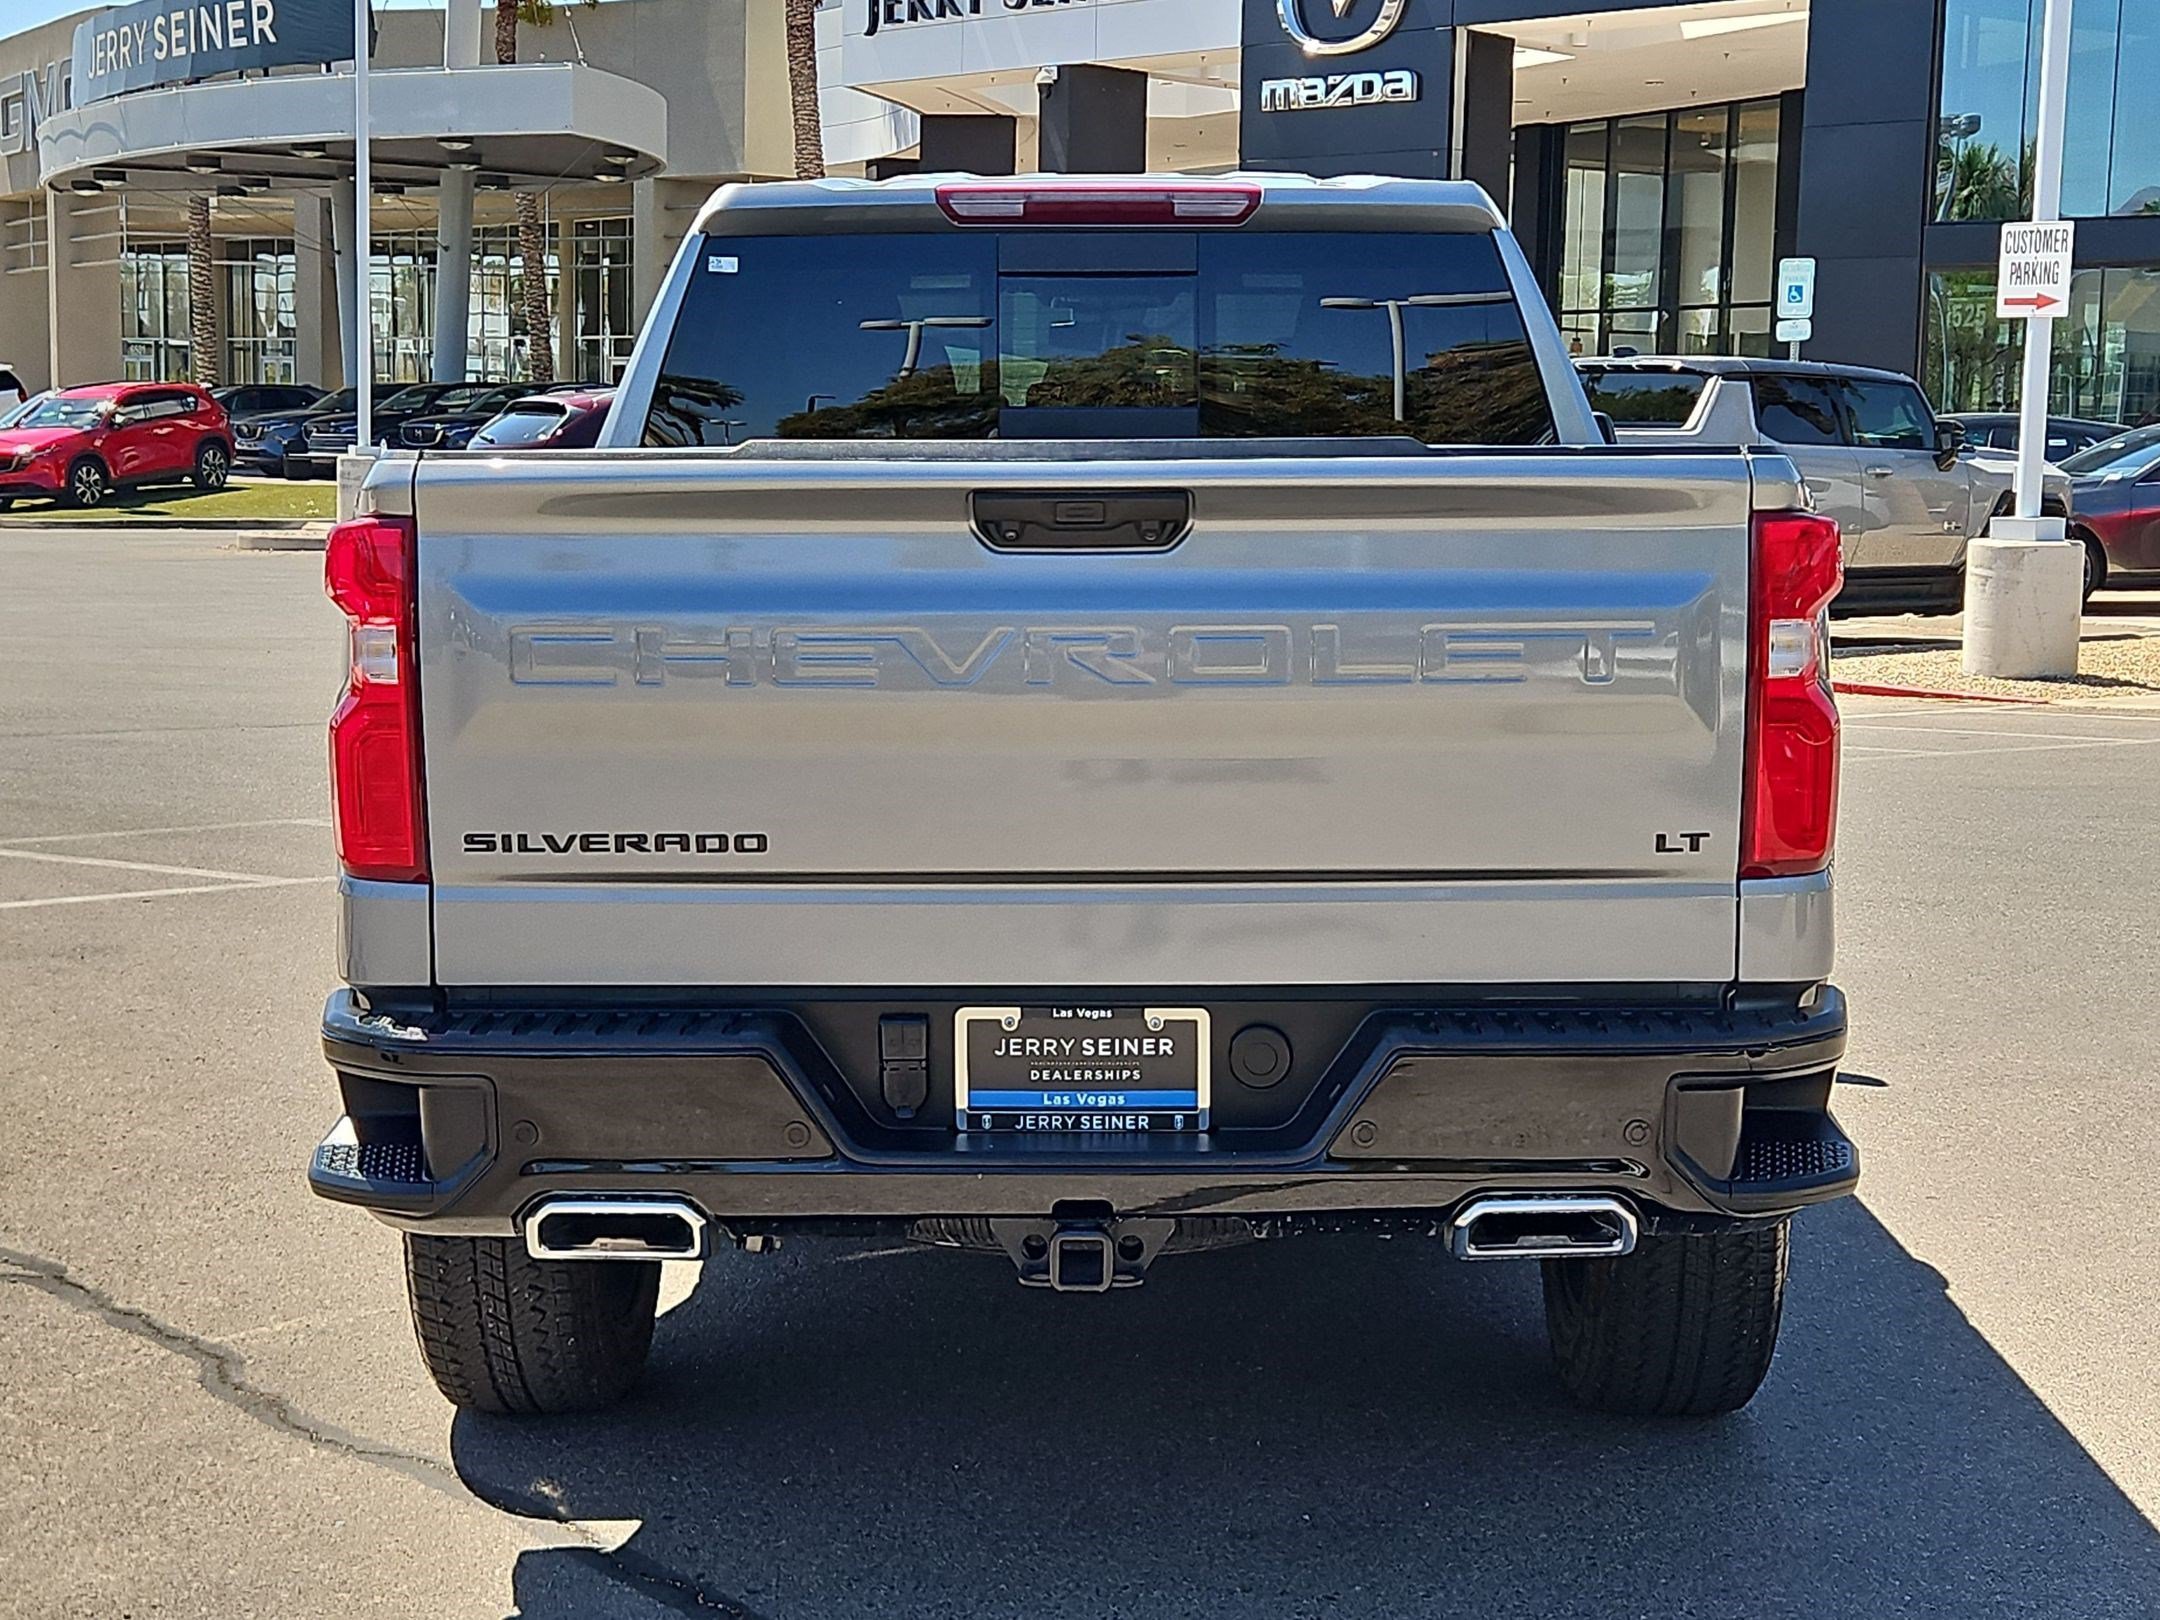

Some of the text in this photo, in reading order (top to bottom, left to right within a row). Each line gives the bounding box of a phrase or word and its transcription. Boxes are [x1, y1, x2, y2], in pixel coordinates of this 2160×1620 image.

[88, 0, 278, 79] JERRY SEINER
[1261, 70, 1418, 112] mazda
[2005, 228, 2069, 254] CUSTOMER
[2009, 260, 2060, 286] PARKING
[509, 621, 1656, 687] CHEVROLET
[463, 832, 769, 855] SILVERADO
[1654, 832, 1711, 855] LT
[1052, 1008, 1113, 1019] Las Vegas
[994, 1038, 1174, 1056] JERRY SEINER
[1030, 1070, 1142, 1081] DEALERSHIPS
[1043, 1093, 1126, 1107] Las Vegas
[1014, 1115, 1150, 1130] JERRY SEINER
